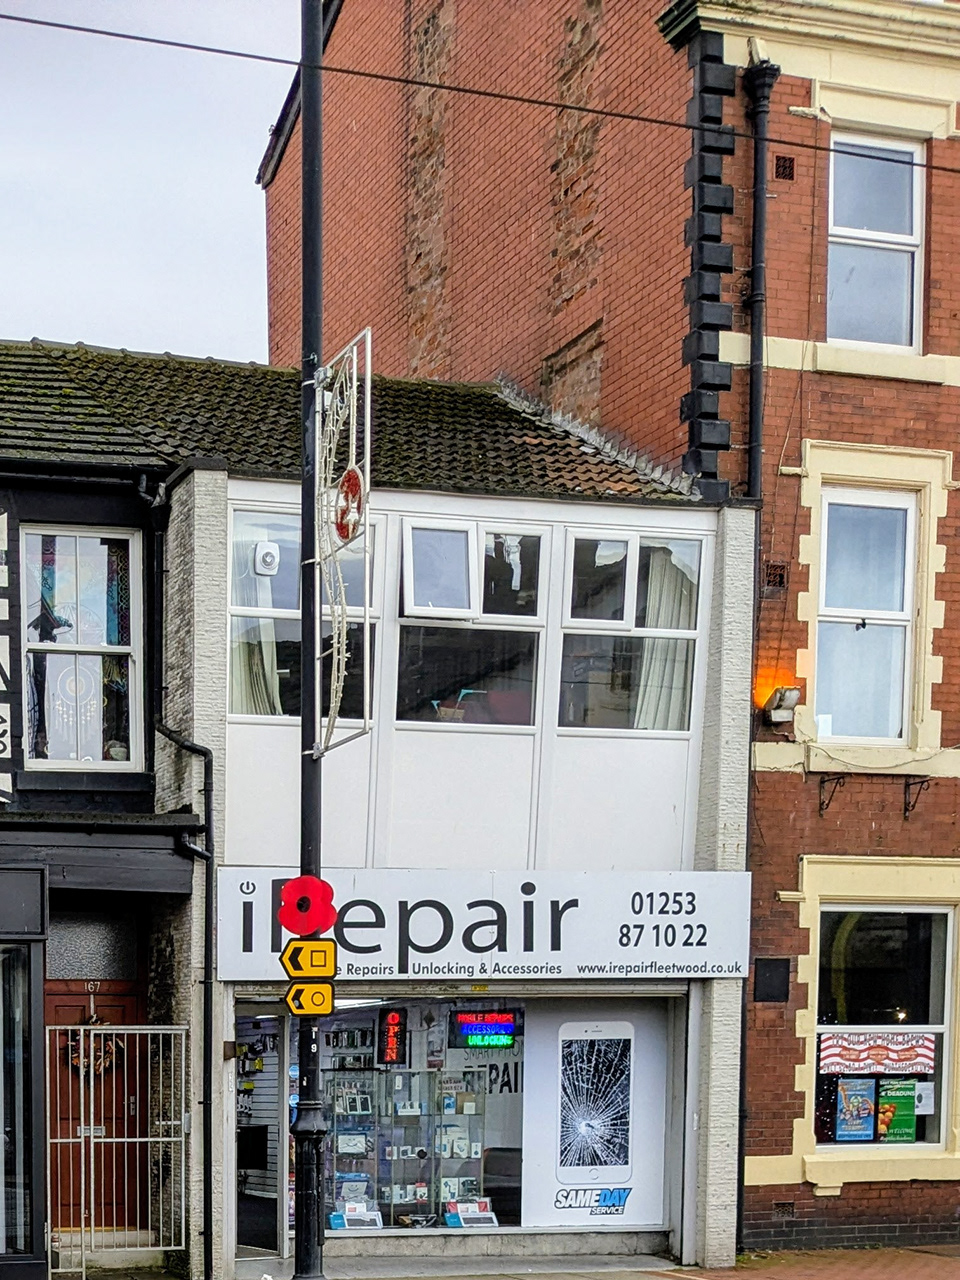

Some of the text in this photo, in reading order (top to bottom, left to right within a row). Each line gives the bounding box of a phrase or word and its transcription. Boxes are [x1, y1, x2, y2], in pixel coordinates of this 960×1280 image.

[631, 891, 697, 916] 01253
[618, 923, 708, 948] 87 10 22
[346, 963, 395, 977] Repairs
[412, 962, 474, 978] Unlocking
[478, 962, 489, 976] &
[492, 962, 563, 975] Accessories
[576, 960, 742, 977] www.irepairfleetwood.co.uk
[83, 982, 101, 993] 167
[591, 1206, 624, 1214] SERVICE
